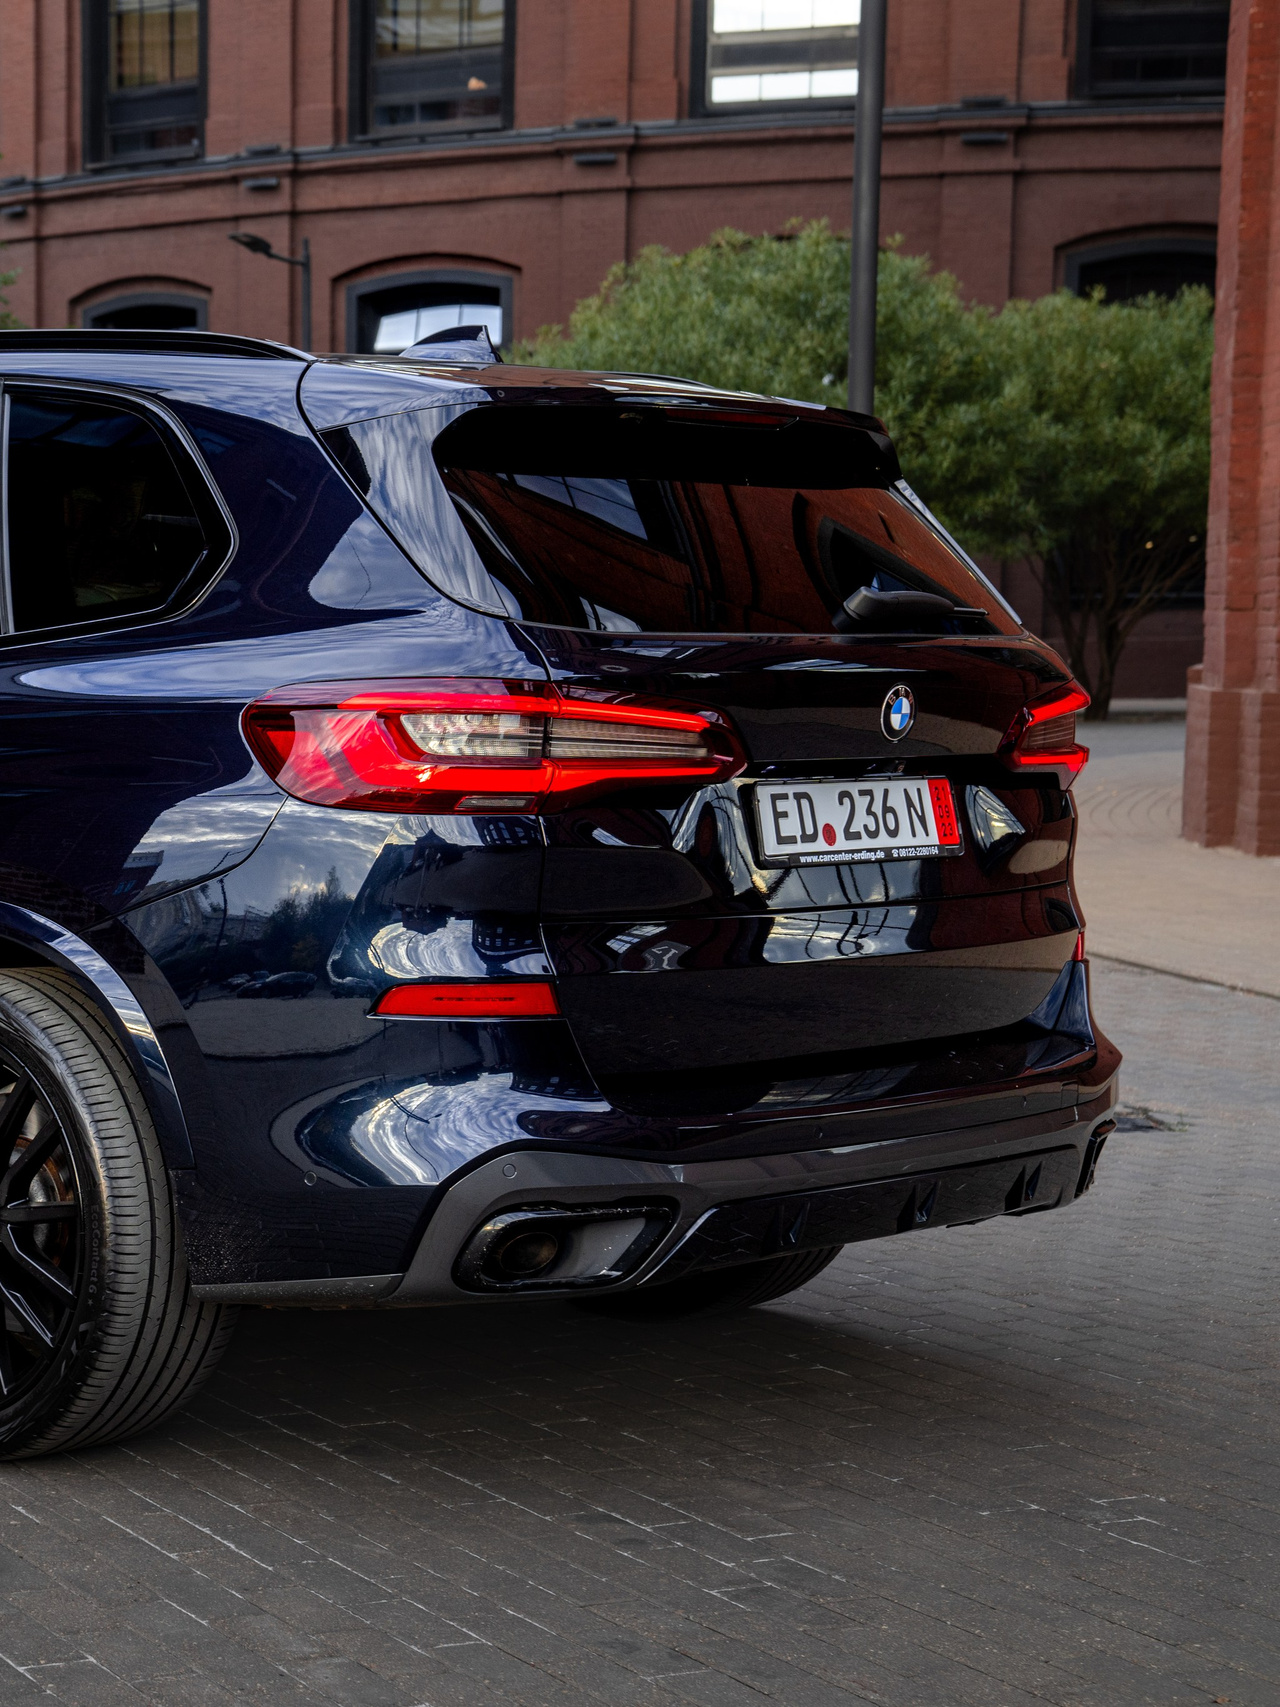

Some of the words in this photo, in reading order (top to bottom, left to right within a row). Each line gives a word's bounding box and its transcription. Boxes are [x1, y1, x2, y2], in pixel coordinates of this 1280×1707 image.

[934, 786, 946, 801] 21
[770, 791, 819, 845] ED
[838, 787, 900, 841] 236
[904, 787, 929, 838] N
[938, 804, 951, 819] 09
[941, 822, 954, 837] 23
[799, 850, 885, 864] www.carcenter-erding.de
[88, 1203, 102, 1282] EcoContact
[87, 1284, 98, 1294] 6
